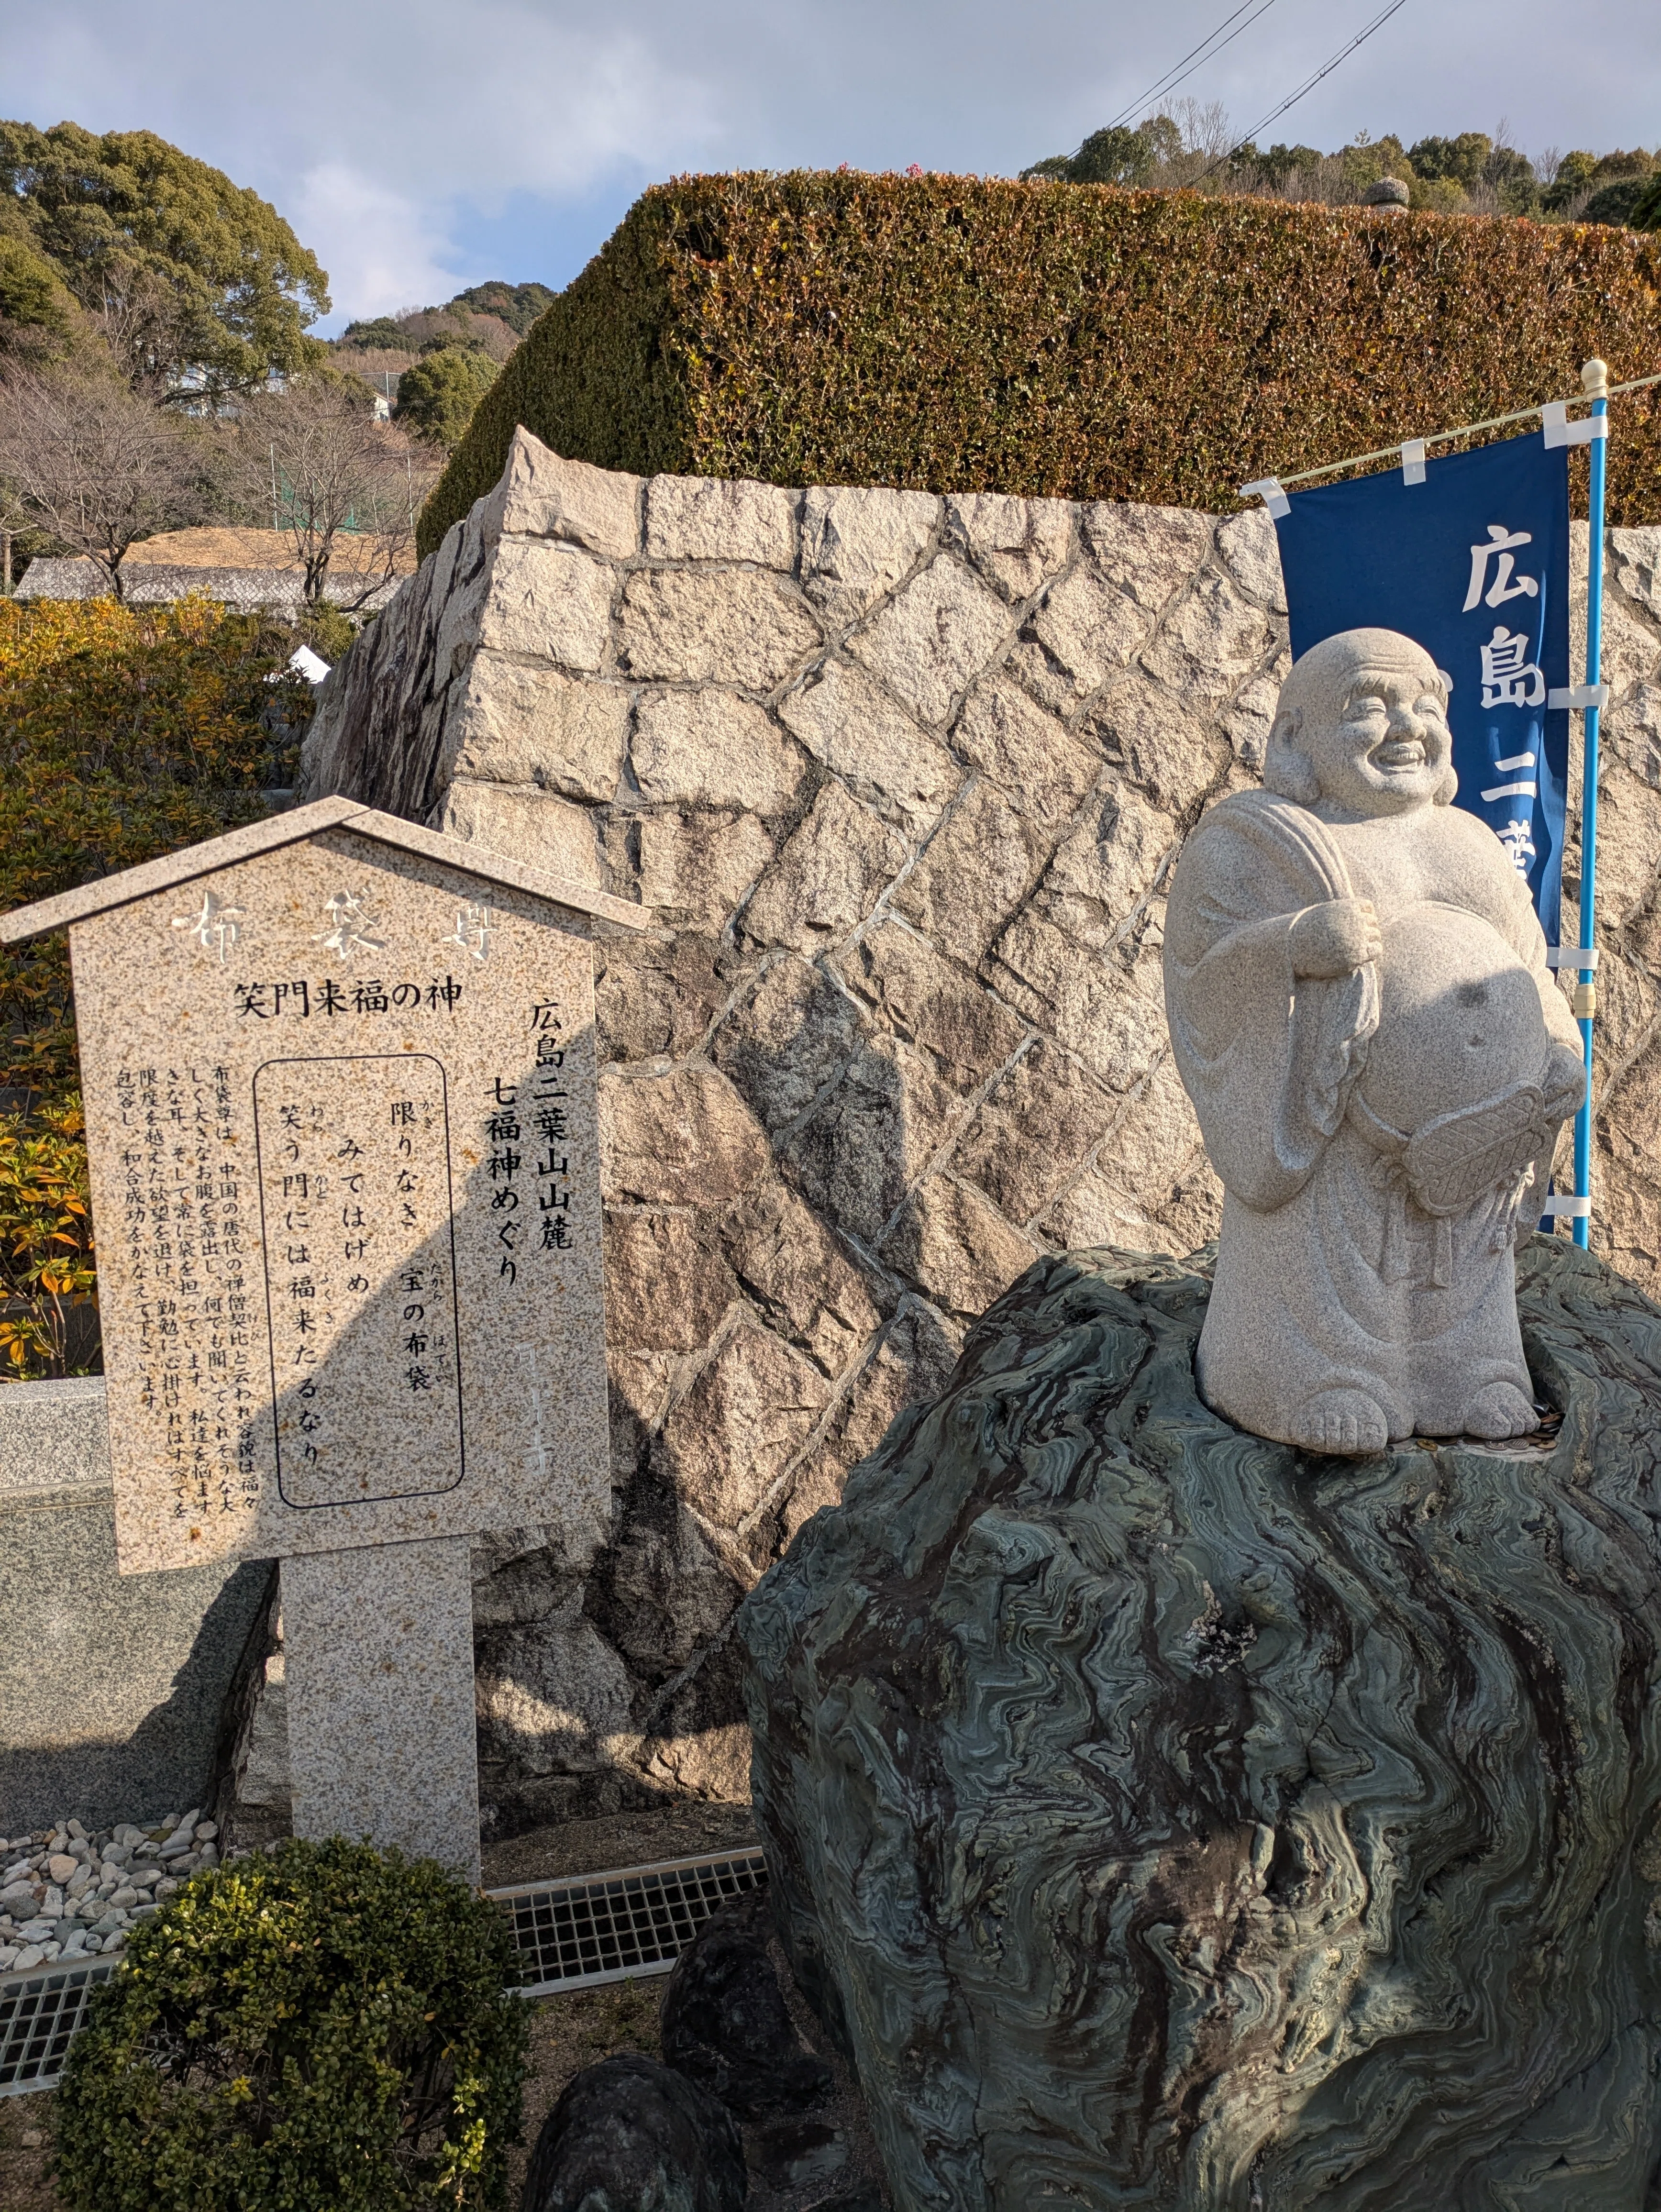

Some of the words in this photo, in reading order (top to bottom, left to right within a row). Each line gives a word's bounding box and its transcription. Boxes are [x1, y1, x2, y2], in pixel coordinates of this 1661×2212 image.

[171, 885, 498, 964] 布袋尊
[233, 975, 463, 1018] 笑門来福の神
[391, 1101, 418, 1227] 限りなき
[483, 1077, 522, 1286] 七福神めぐり
[530, 997, 573, 1250] 広島二葉山山麓
[279, 1105, 321, 1465] 笑う門には福来たるなり
[337, 1139, 371, 1294] みてはげめ
[399, 1268, 432, 1393] 宝の布袋
